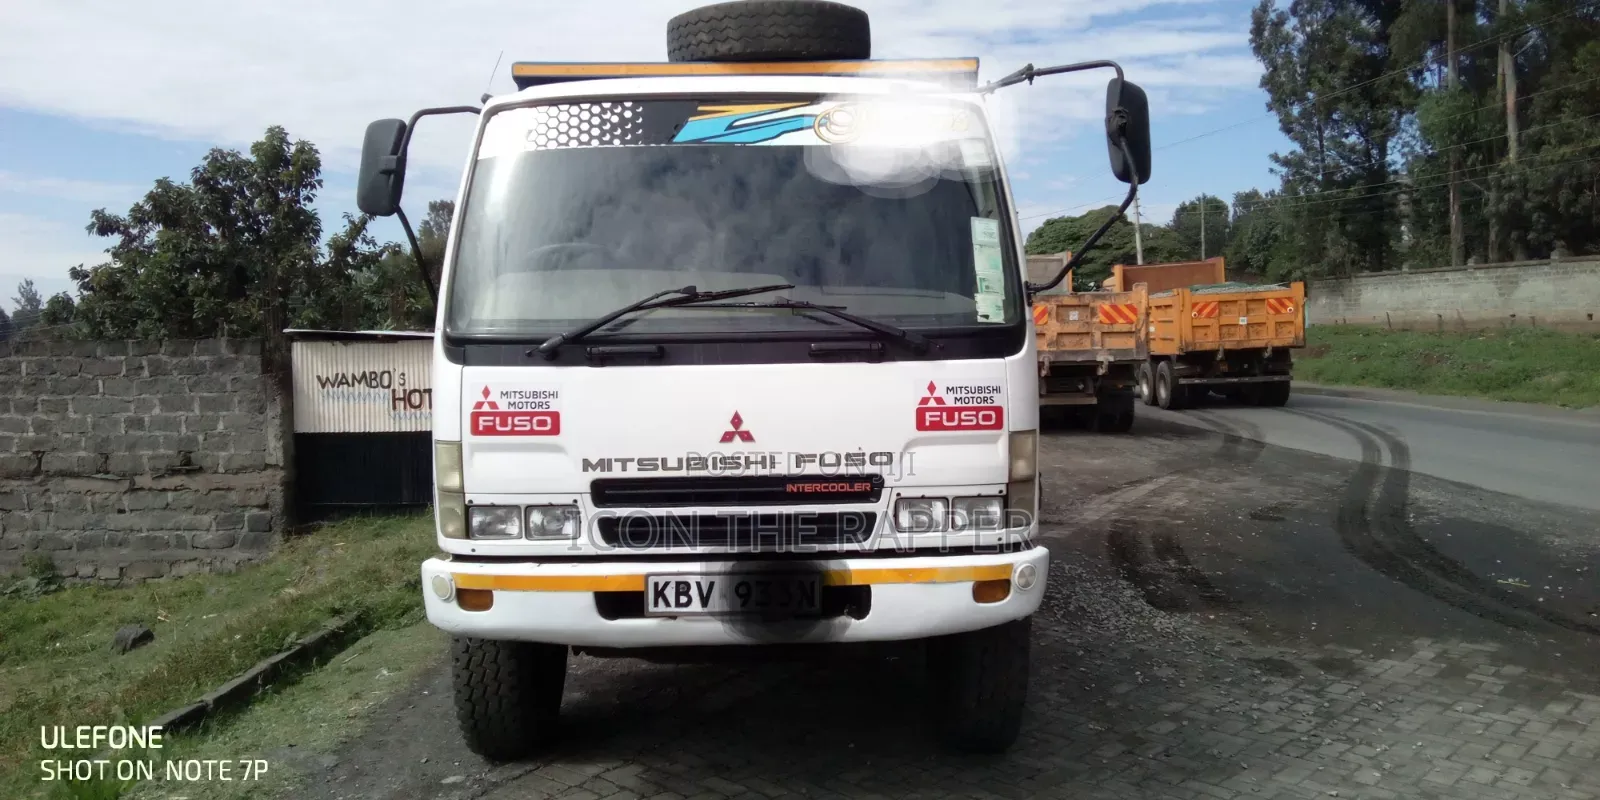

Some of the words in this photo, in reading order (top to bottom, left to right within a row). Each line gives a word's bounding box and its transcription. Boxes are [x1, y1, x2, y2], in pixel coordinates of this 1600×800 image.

[500, 390, 559, 400] MITSUBISHI
[945, 386, 1001, 395] MITSUBISHI
[508, 401, 551, 410] MOTORS
[954, 396, 995, 405] MOTORS
[478, 416, 552, 431] FUSO
[925, 410, 996, 426] FUSO
[582, 455, 776, 472] MITSUBISHI
[795, 452, 893, 468] FUSO
[786, 482, 872, 494] INTERCOOLER
[653, 581, 715, 608] KBV
